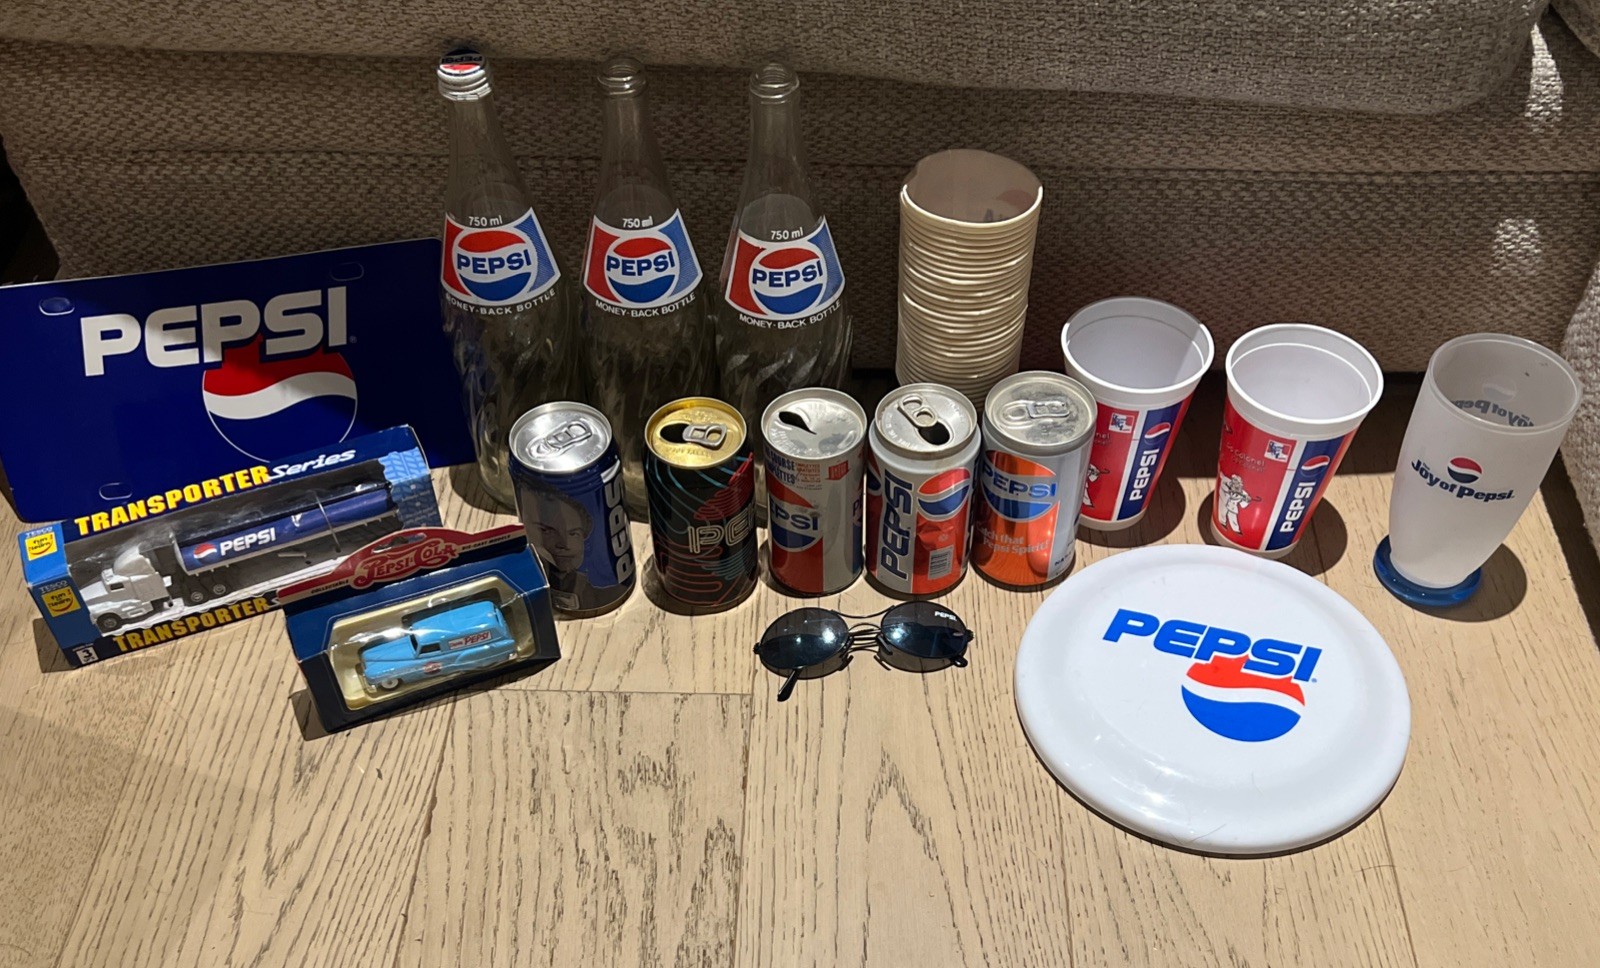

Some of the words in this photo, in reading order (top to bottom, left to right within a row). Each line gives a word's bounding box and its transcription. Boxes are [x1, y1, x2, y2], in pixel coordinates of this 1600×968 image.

[469, 216, 487, 227] 750
[489, 214, 503, 226] ml
[622, 218, 640, 229] 750
[641, 215, 654, 228] ml
[771, 230, 789, 240] 750
[791, 227, 804, 239] ml
[457, 249, 532, 275] PEPSI
[606, 251, 676, 277] PEPSI
[752, 260, 824, 288] PEPSI
[516, 288, 557, 313] BOTTLE
[595, 299, 660, 318] MONEY-BACK
[661, 292, 696, 315] BOTTLE
[739, 314, 807, 329] MONEY-BACK
[809, 299, 842, 324] BOTTLE
[80, 286, 347, 377] PEPSI
[1234, 449, 1265, 467] Colonel
[981, 463, 1057, 499] PEPSI
[1129, 447, 1160, 501] PEPSI
[1411, 459, 1440, 487] Joy
[1438, 481, 1458, 493] of
[74, 465, 271, 536] TRANSPORTER
[267, 448, 357, 481] Series
[769, 496, 819, 531] EPSI
[1279, 481, 1316, 533] PEPSI
[25, 526, 54, 539] TESCO
[881, 468, 914, 580] PEPSI
[220, 528, 277, 556] PEPSI
[983, 536, 1010, 554] Pepsi
[1000, 532, 1025, 545] that
[39, 580, 69, 594] TESCO
[112, 597, 272, 651] TRANSPORTER
[934, 610, 957, 621] PEPSI
[1102, 608, 1323, 682] PEPSI
